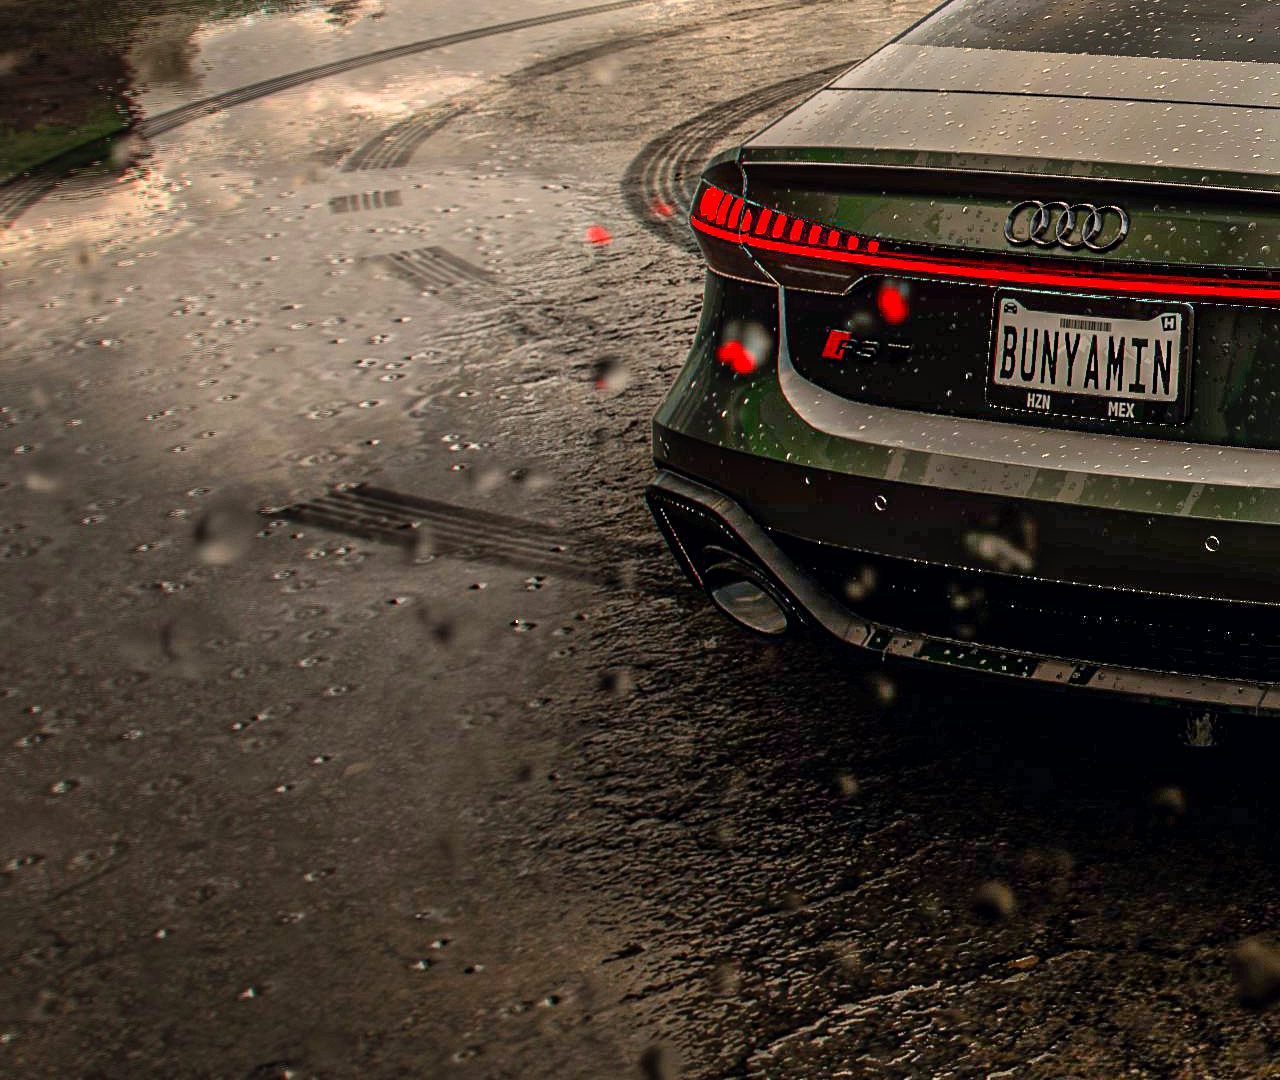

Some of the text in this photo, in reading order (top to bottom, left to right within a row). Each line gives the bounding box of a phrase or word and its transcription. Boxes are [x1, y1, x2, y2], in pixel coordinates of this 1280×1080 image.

[1000, 325, 1172, 395] BUNYAMIN
[1026, 392, 1051, 410] HZN
[1108, 401, 1135, 418] MEX
